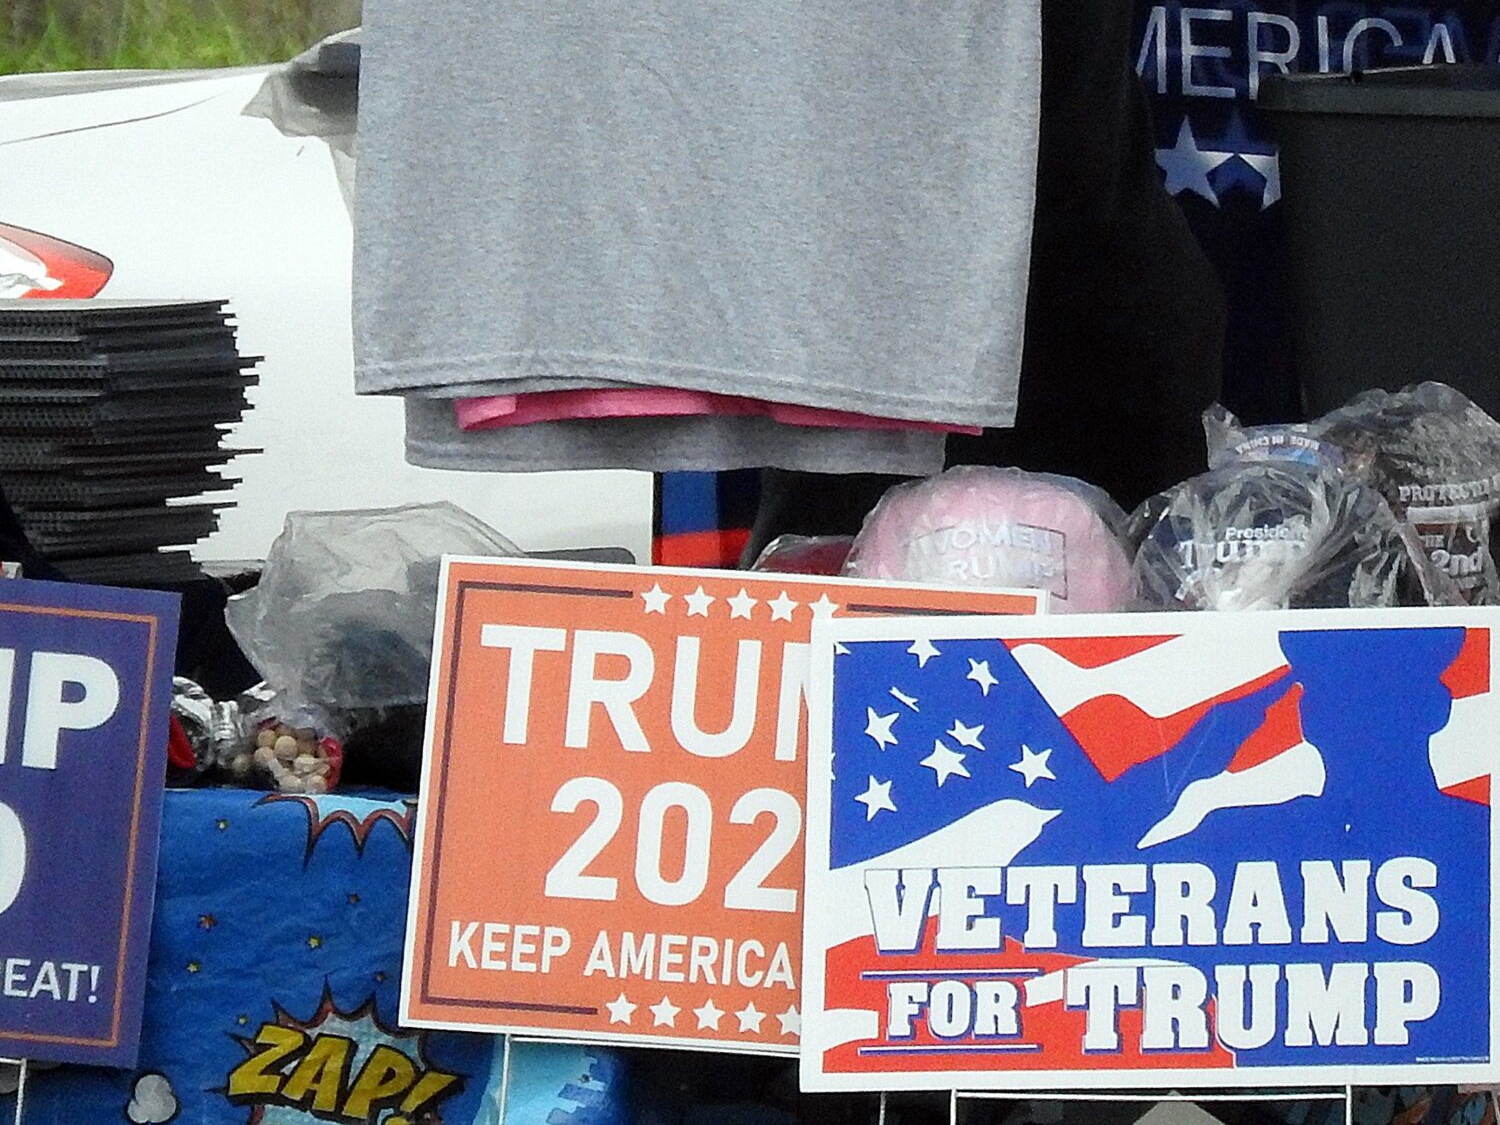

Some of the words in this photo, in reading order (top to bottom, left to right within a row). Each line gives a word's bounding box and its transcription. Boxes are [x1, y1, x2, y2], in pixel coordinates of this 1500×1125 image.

[0, 648, 120, 770] P
[863, 857, 1441, 953] VETERANS
[0, 957, 100, 1004] EAT!
[449, 921, 572, 974] KEEP
[583, 930, 797, 991] AMERICA
[887, 979, 1021, 1038] FOR
[1066, 960, 1443, 1054] TRUMP
[229, 1023, 459, 1125] ZAP!
